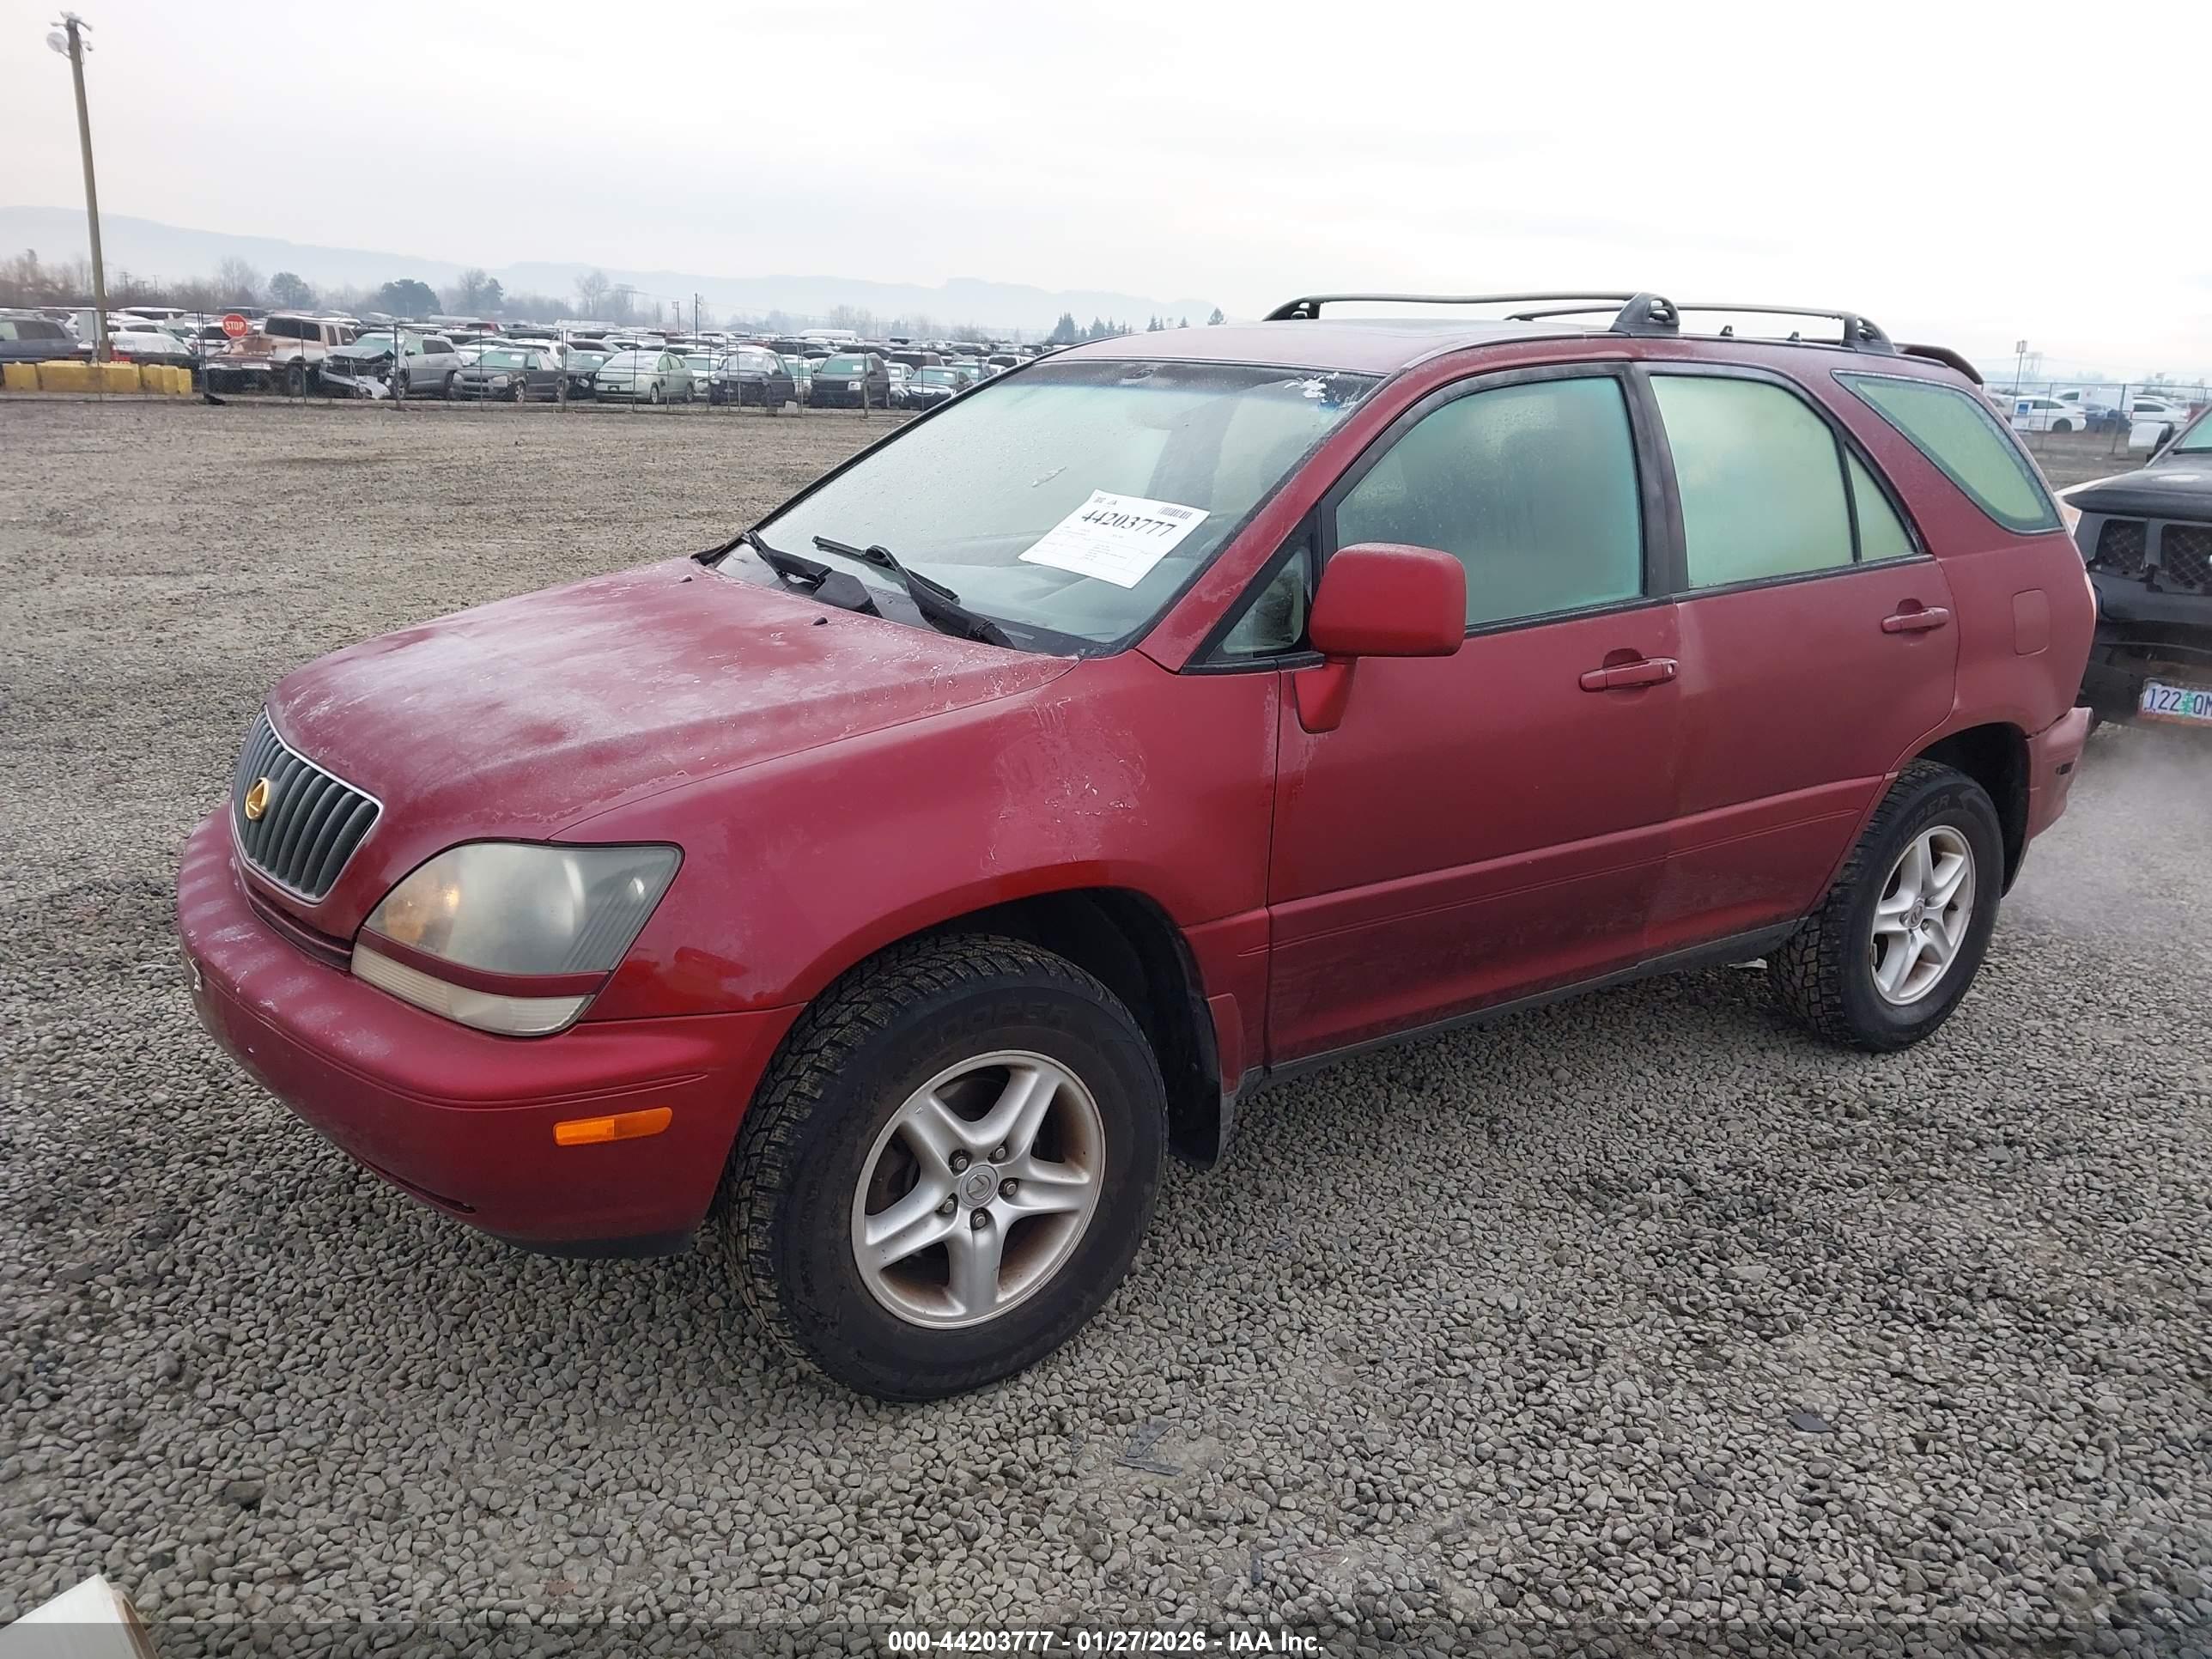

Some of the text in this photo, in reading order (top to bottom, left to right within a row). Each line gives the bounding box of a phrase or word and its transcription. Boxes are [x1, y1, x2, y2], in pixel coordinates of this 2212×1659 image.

[225, 321, 245, 331] STOP
[1081, 510, 1177, 538] 44203777
[2149, 688, 2183, 712] 122
